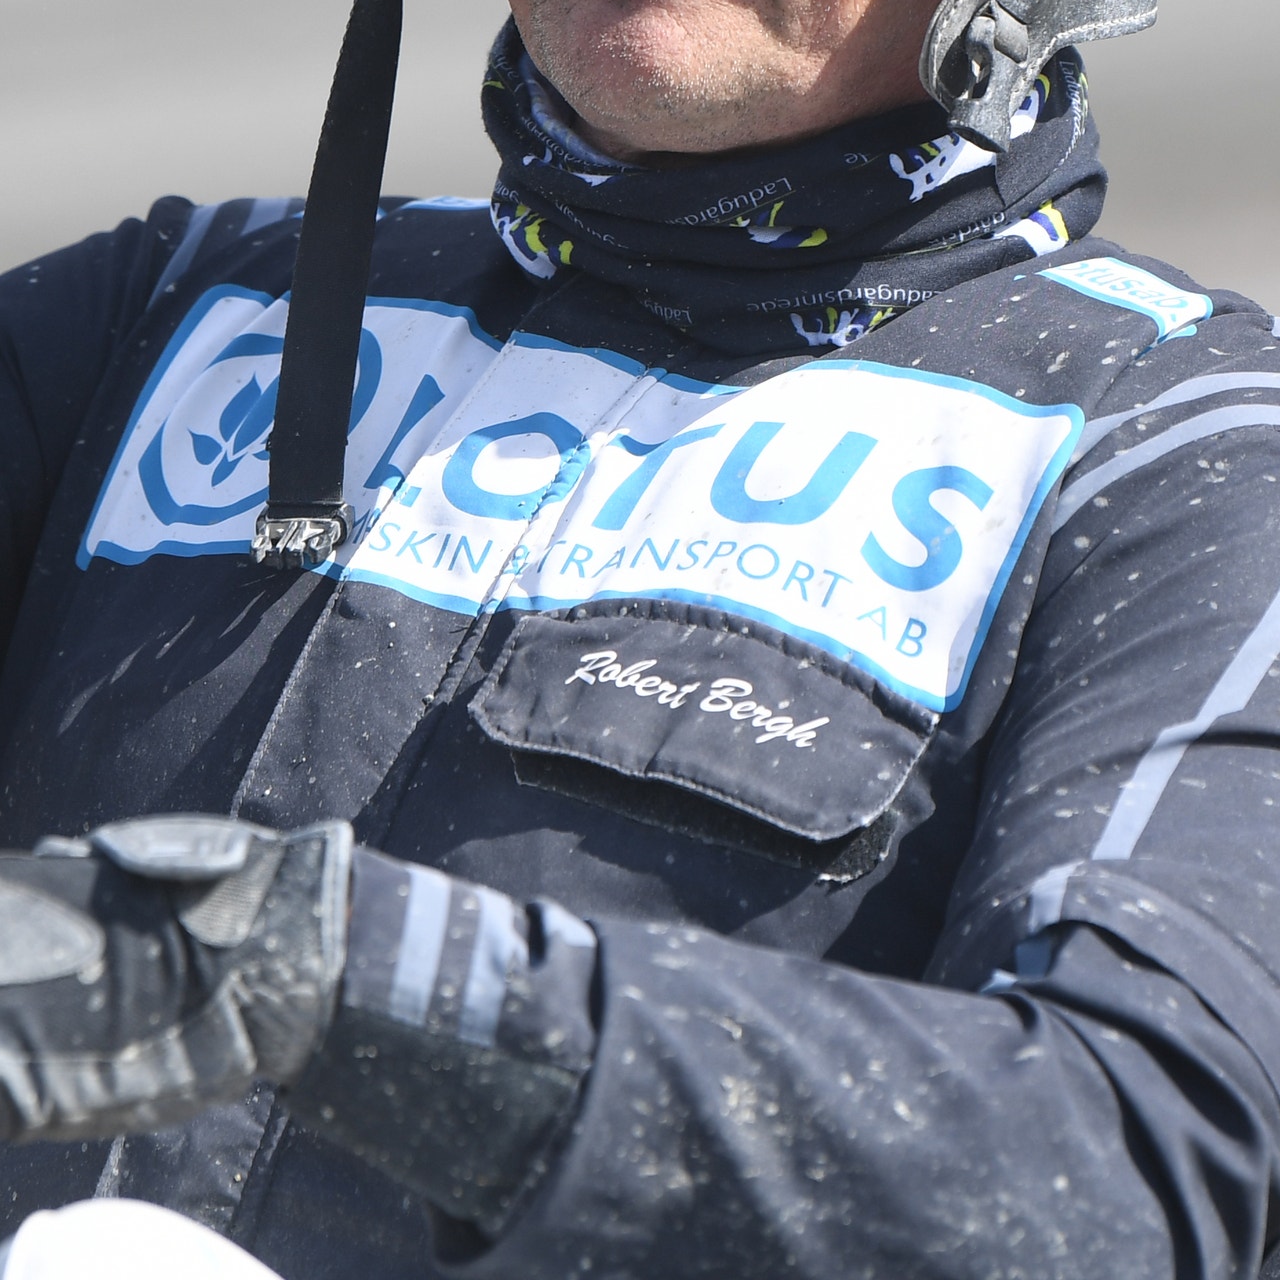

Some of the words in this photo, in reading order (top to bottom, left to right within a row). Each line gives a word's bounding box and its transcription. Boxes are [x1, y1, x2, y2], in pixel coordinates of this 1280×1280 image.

[363, 373, 995, 593] LOTUS
[536, 536, 854, 609] TRANSPORT
[856, 604, 929, 659] AB
[564, 649, 701, 710] Robert
[699, 677, 831, 748] Bergh
